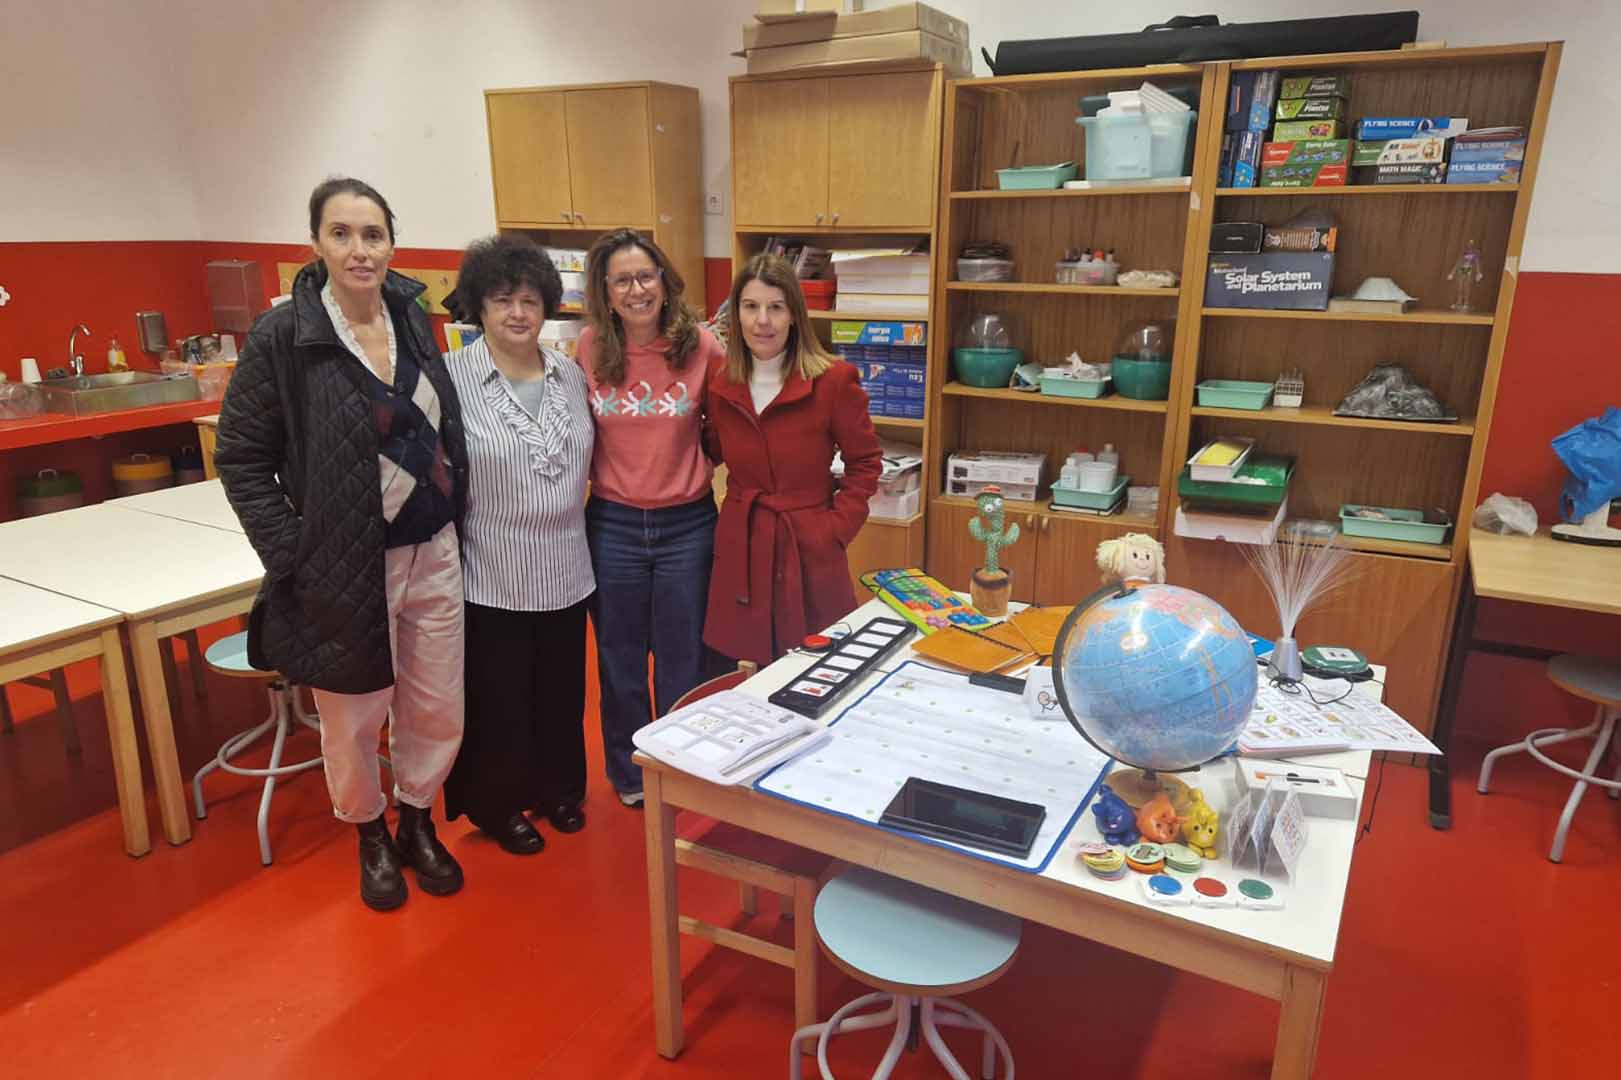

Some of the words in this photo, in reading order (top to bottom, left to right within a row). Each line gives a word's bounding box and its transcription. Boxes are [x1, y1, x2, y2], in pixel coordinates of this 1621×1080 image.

[1363, 120, 1388, 128] FLYING
[1389, 119, 1417, 128] SCIENCE
[1455, 142, 1480, 150] FLYING
[1480, 140, 1511, 150] SCIENCE
[1379, 164, 1399, 173] MATH
[1400, 163, 1423, 173] MAGIC
[1450, 163, 1476, 172] FLYING
[1477, 161, 1505, 172] SCIENCE
[1224, 271, 1260, 285] Solar
[1261, 269, 1312, 284] System
[1241, 280, 1322, 295] Planetarium
